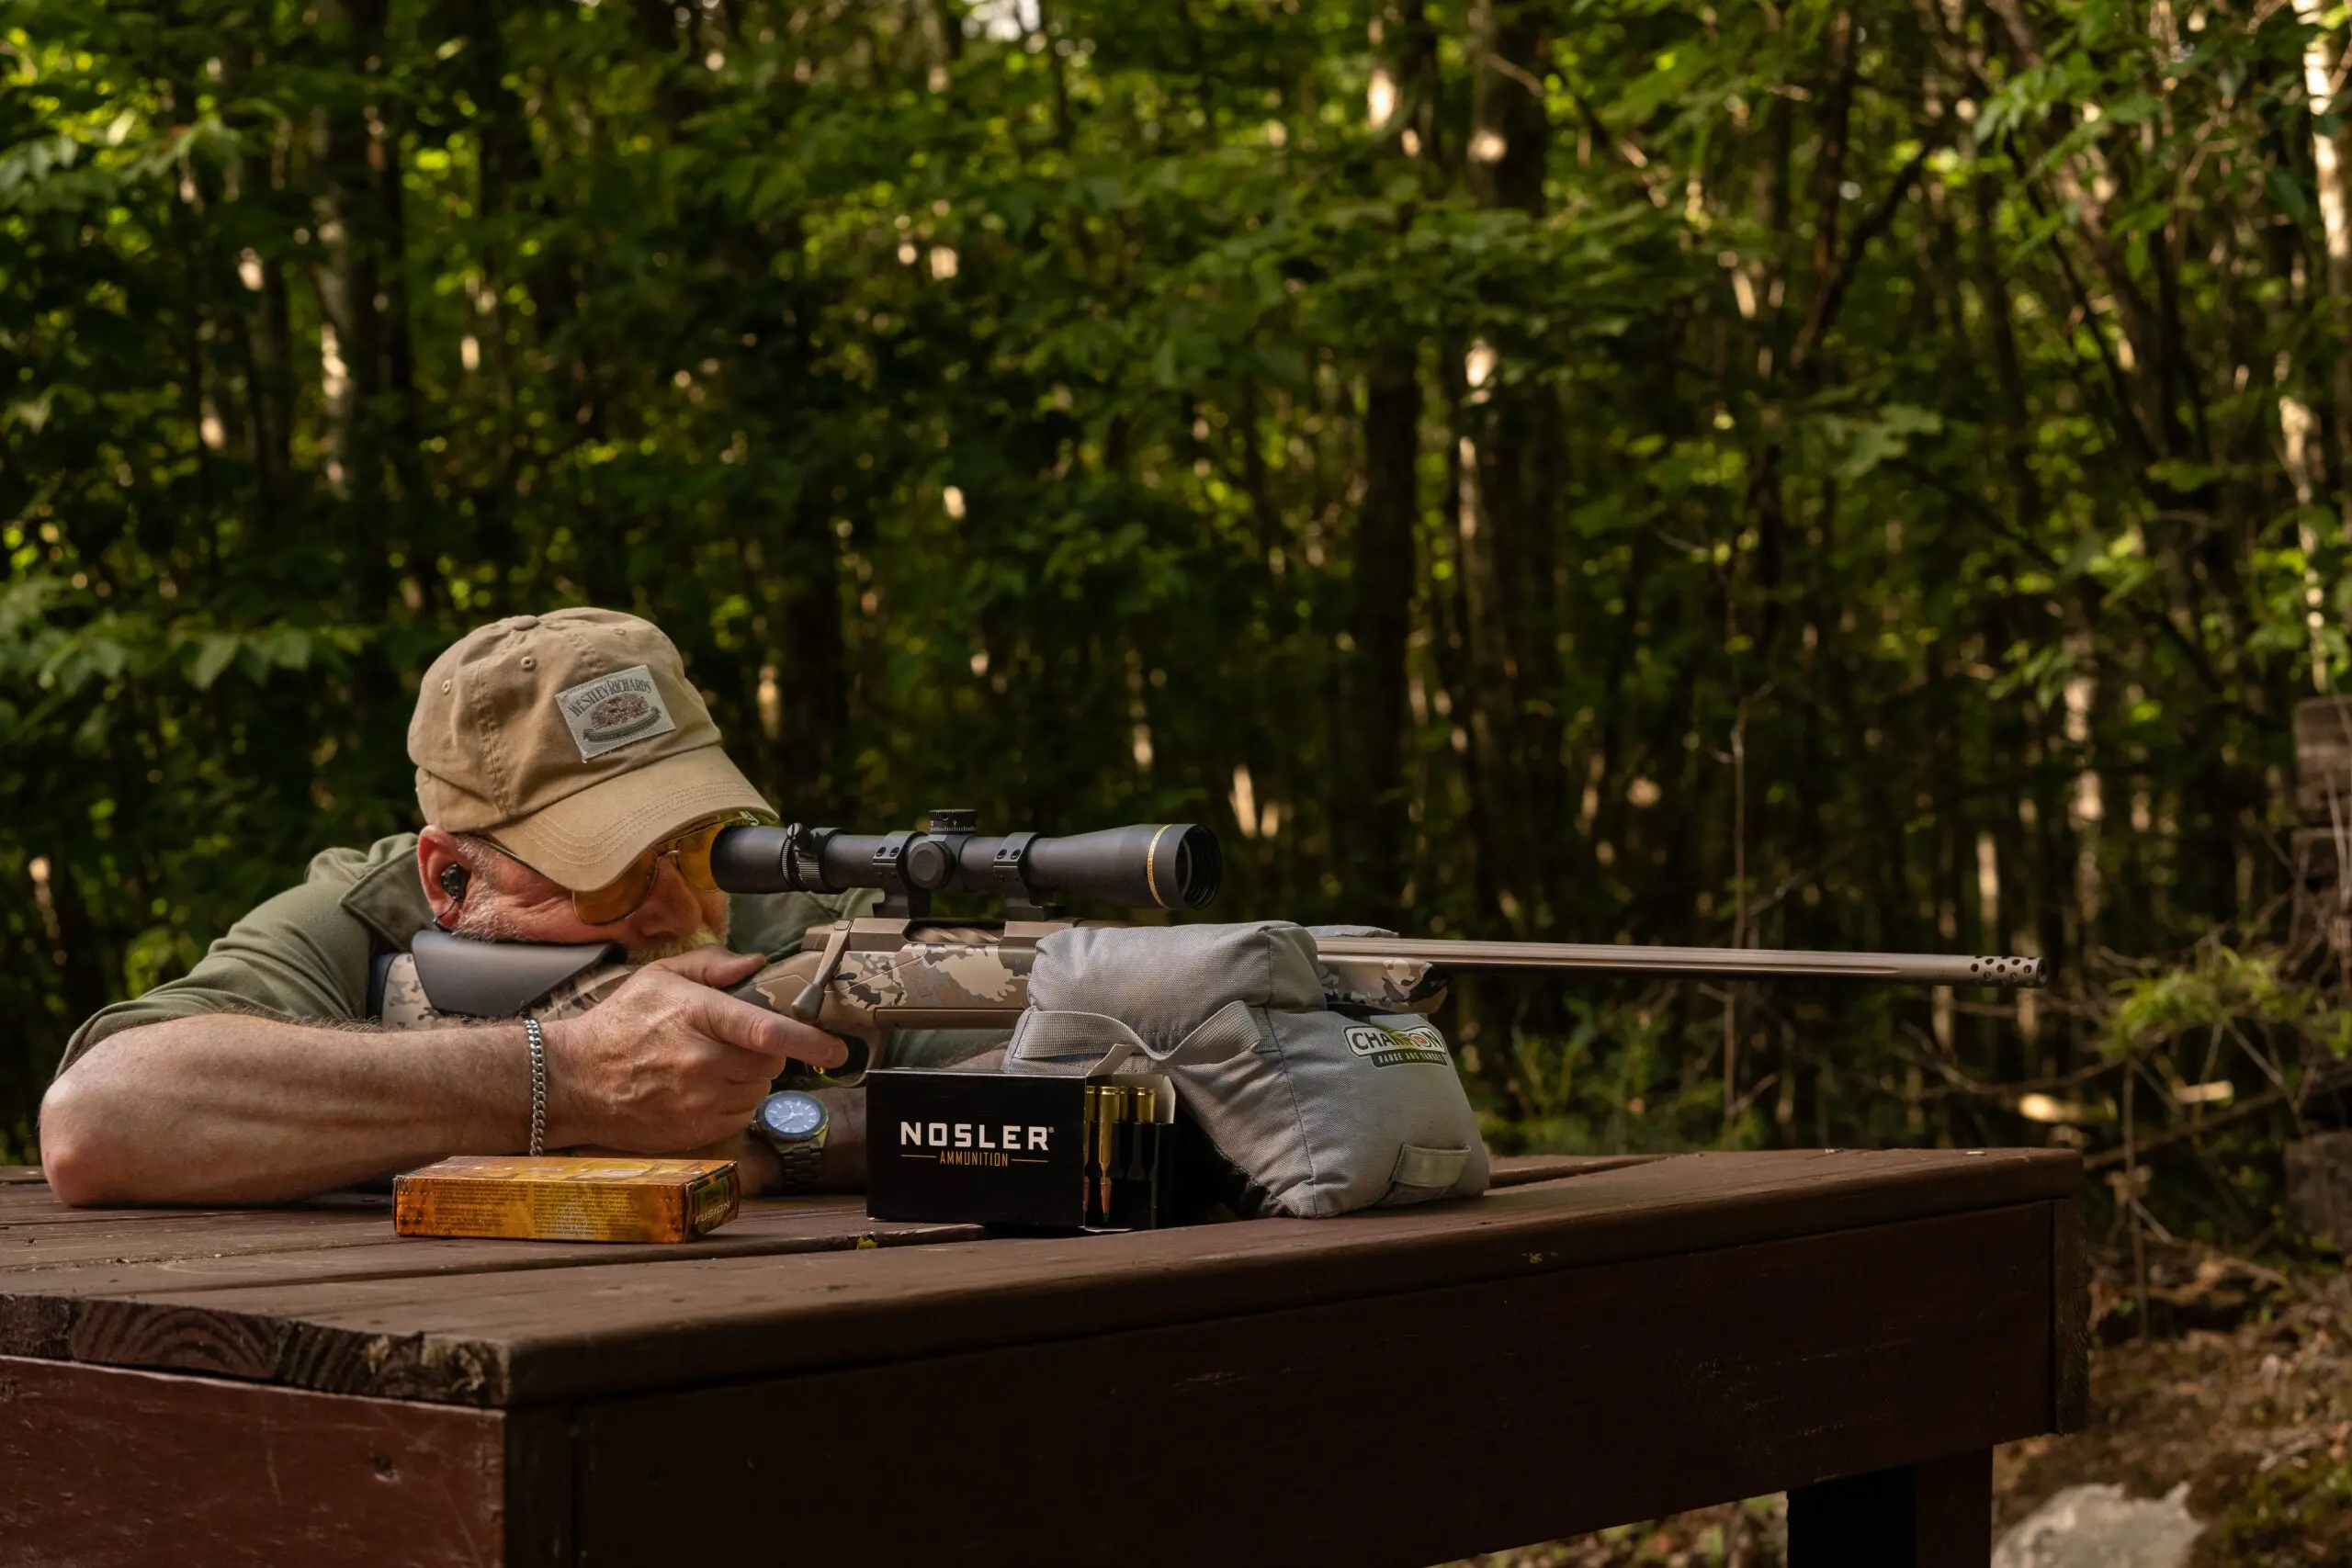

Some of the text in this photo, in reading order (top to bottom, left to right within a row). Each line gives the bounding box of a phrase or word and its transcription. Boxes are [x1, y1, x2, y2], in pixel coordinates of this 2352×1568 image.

[568, 678, 651, 717] WESTLEY RICHARDS
[1378, 1053, 1403, 1064] RANGE
[940, 1150, 1009, 1168] AMMUNITION
[695, 1201, 730, 1225] FUSION
